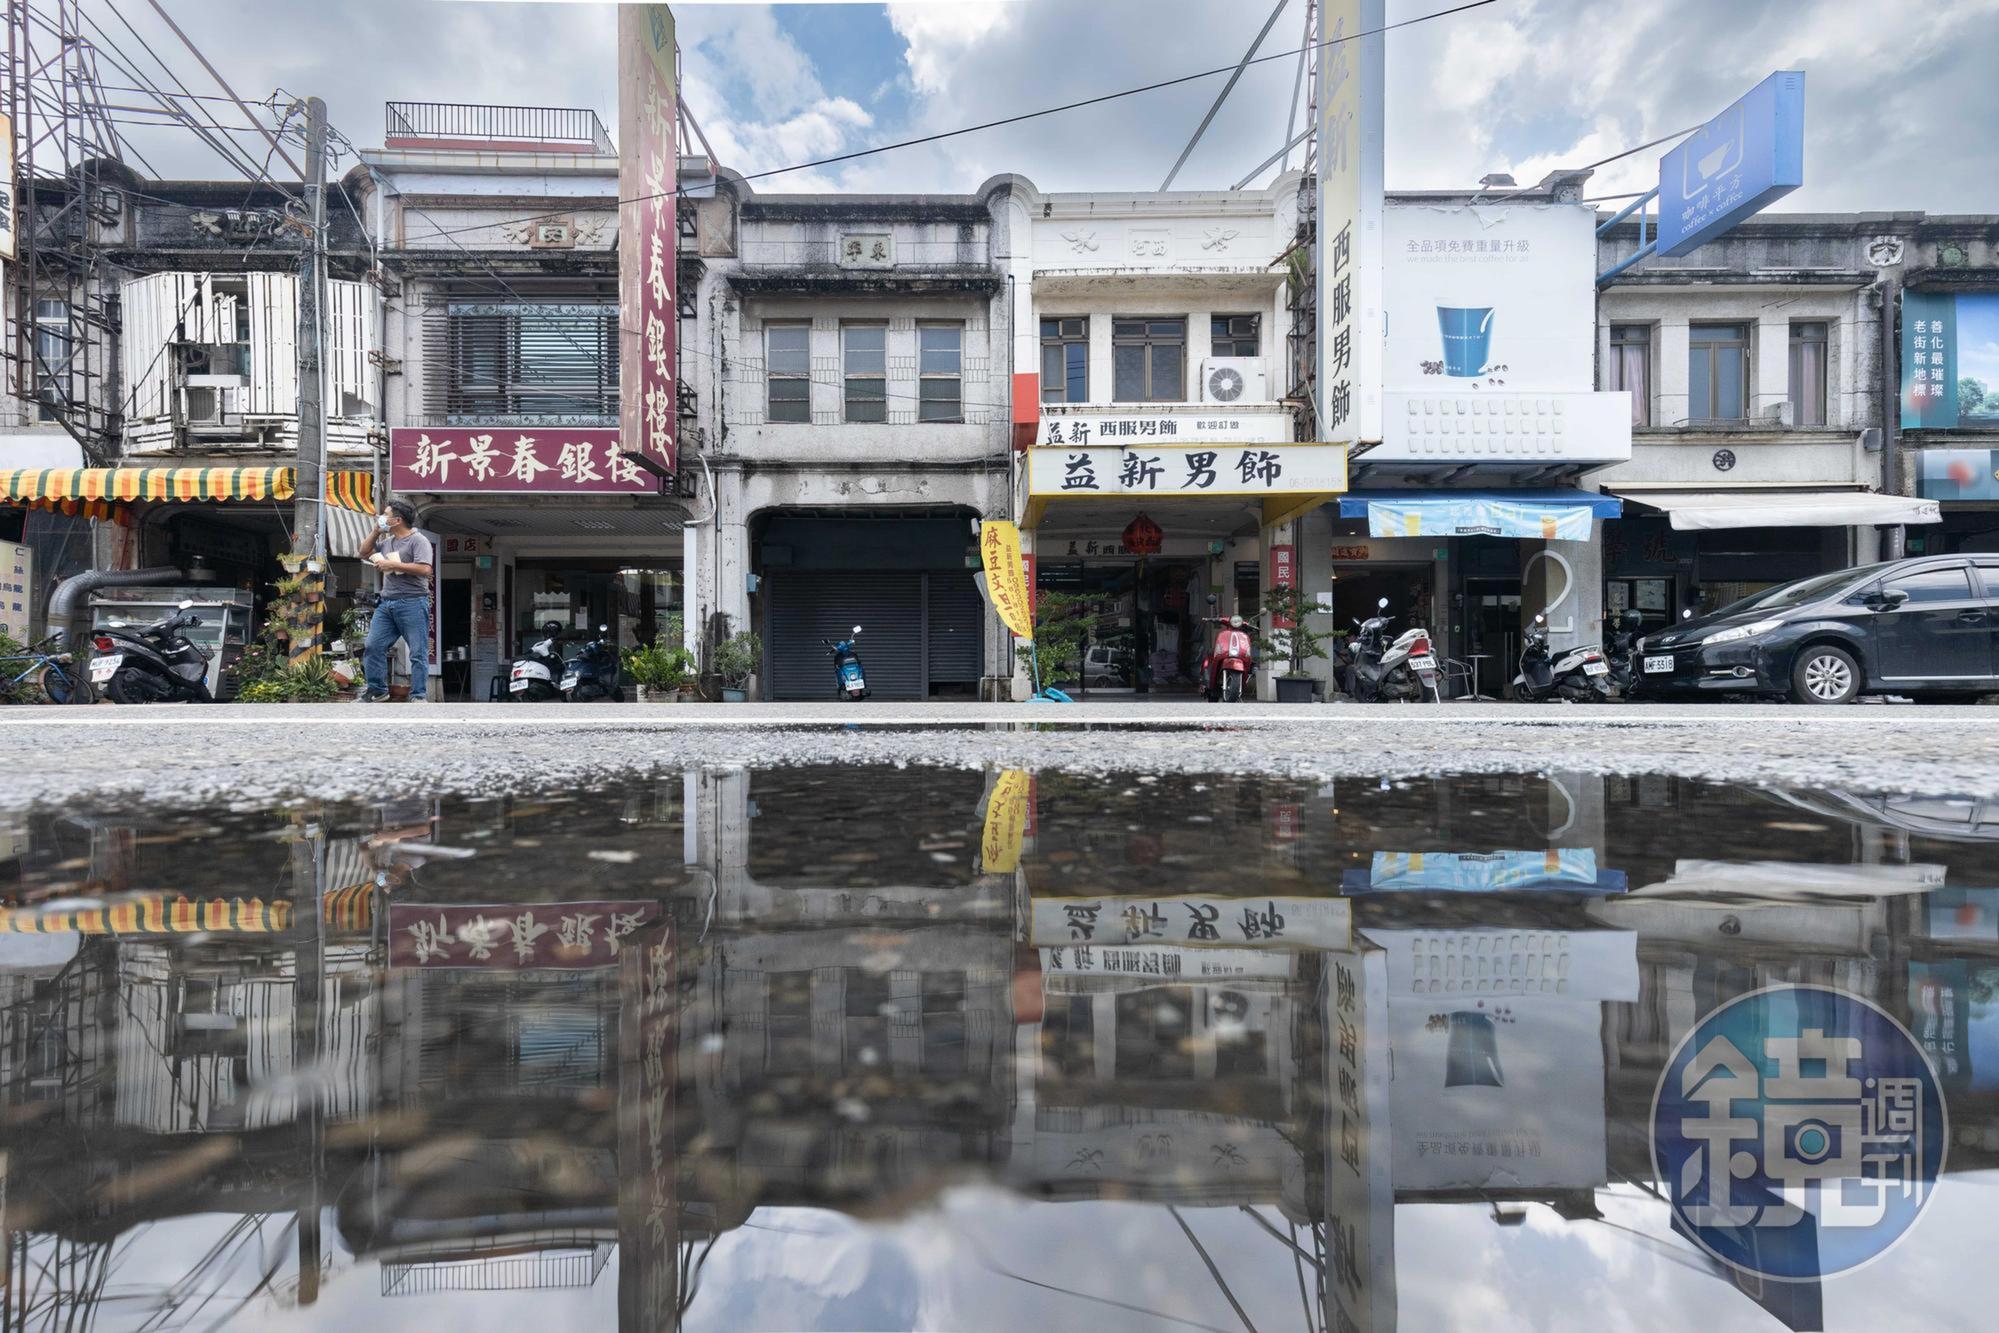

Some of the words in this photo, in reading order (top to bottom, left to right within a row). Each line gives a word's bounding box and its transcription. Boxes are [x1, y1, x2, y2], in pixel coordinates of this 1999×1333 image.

[645, 68, 672, 467] 新景春銀樓
[1407, 239, 1529, 253] 全品項免費重量升級
[1331, 218, 1352, 431] 西服男飾
[1912, 320, 1927, 397] 老街新地標
[1930, 320, 1944, 397] 善化最璀璨
[1099, 420, 1178, 436] 西服男飾
[1061, 450, 1283, 490] 益新男飾
